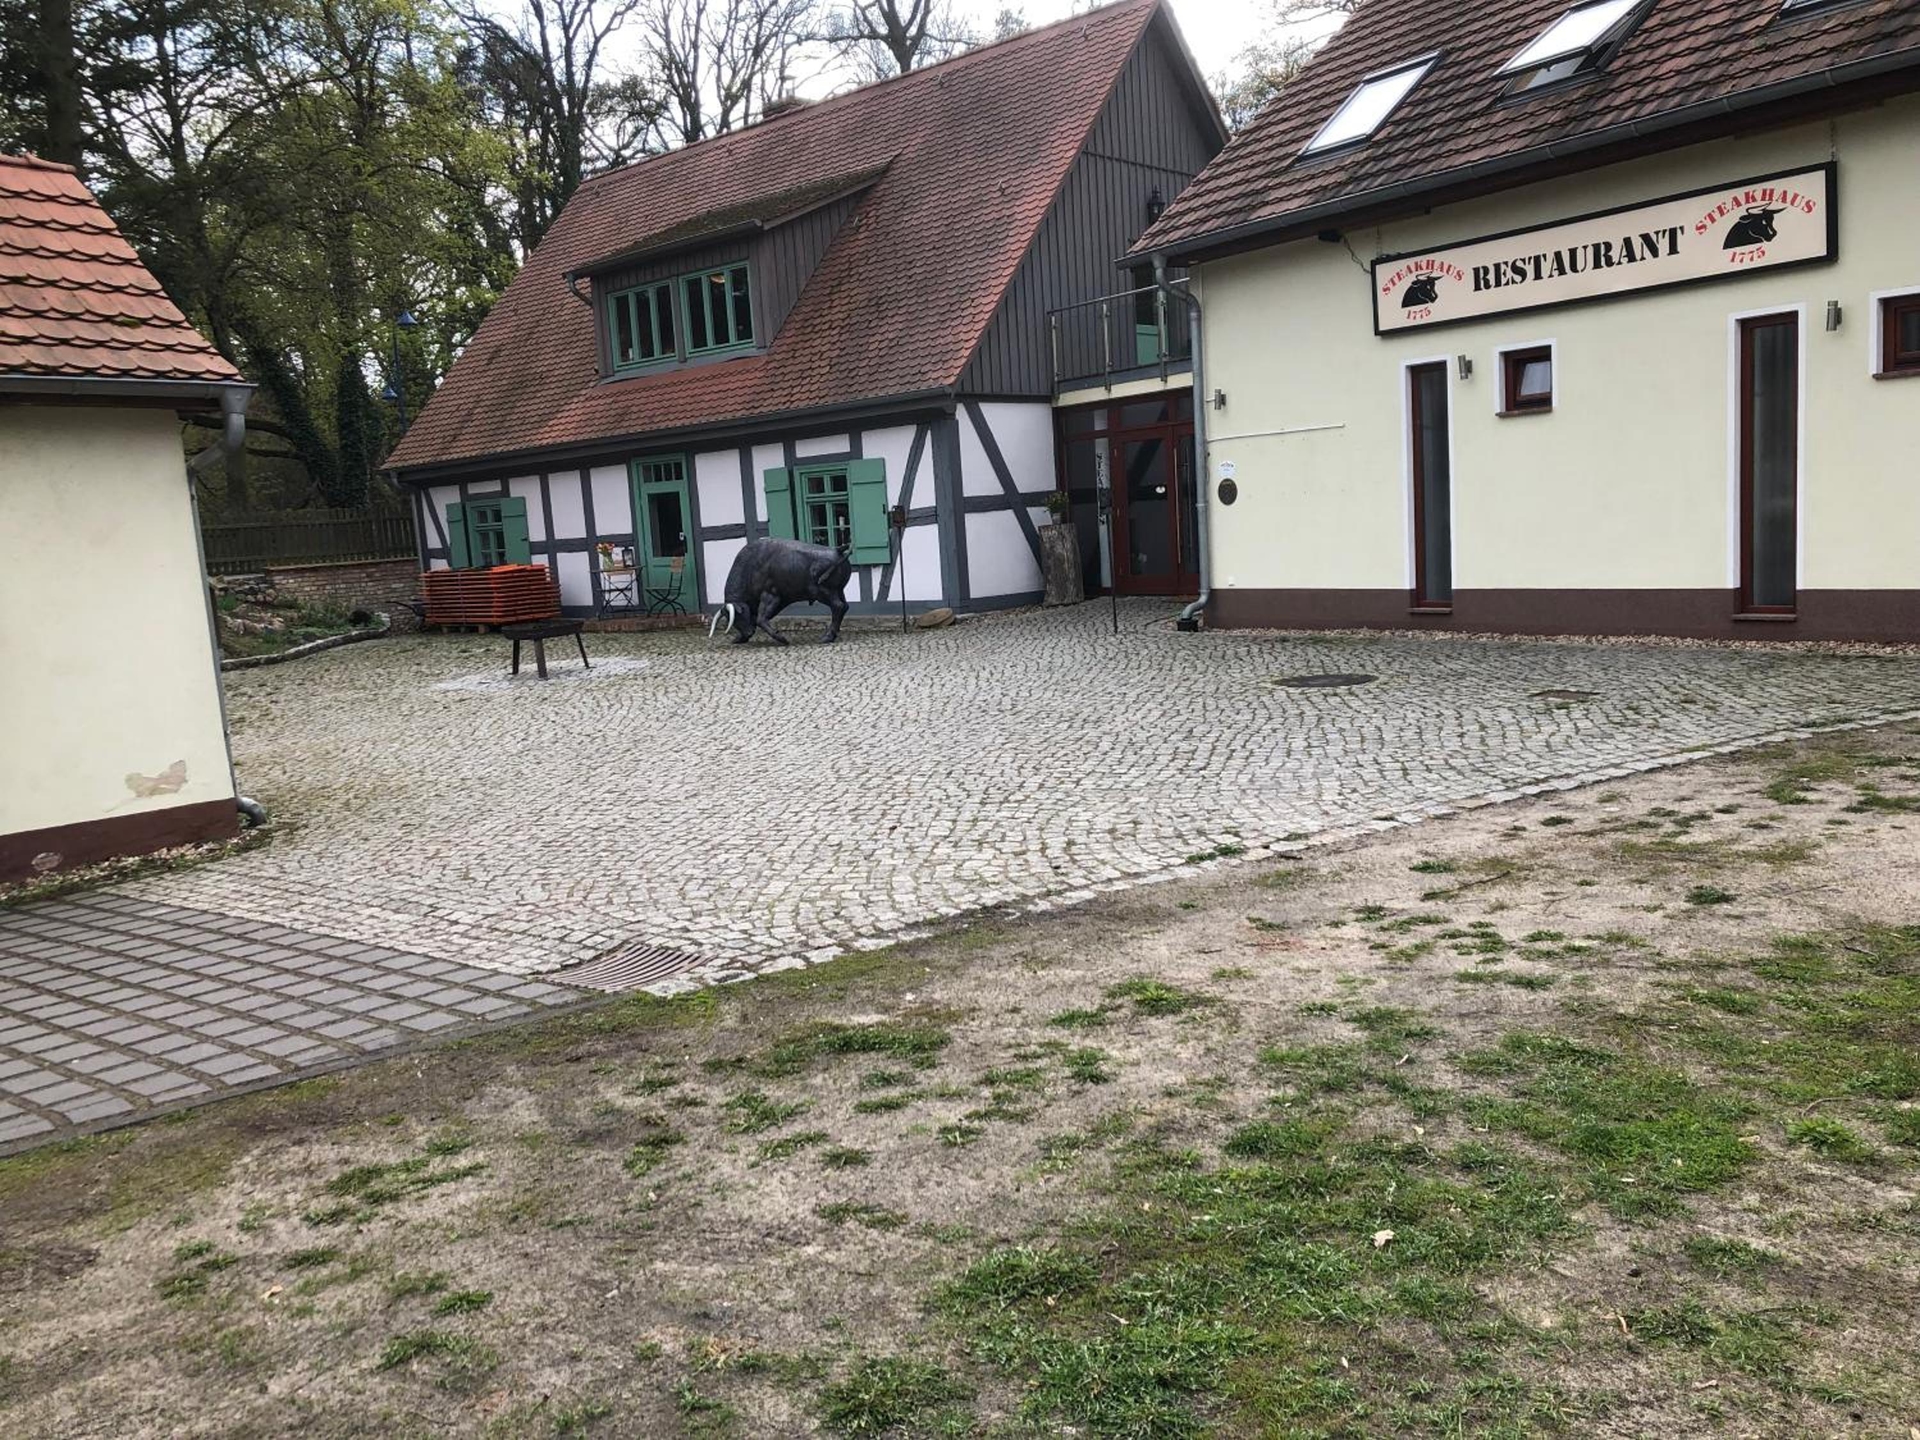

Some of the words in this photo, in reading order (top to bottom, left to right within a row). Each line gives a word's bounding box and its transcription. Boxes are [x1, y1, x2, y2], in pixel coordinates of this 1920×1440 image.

[1695, 187, 1817, 235] STEAKHAUS
[1472, 226, 1685, 292] RESTAURANT
[1729, 246, 1766, 264] 1775
[1382, 260, 1464, 295] STEAKHAUS
[1405, 306, 1432, 320] 1775
